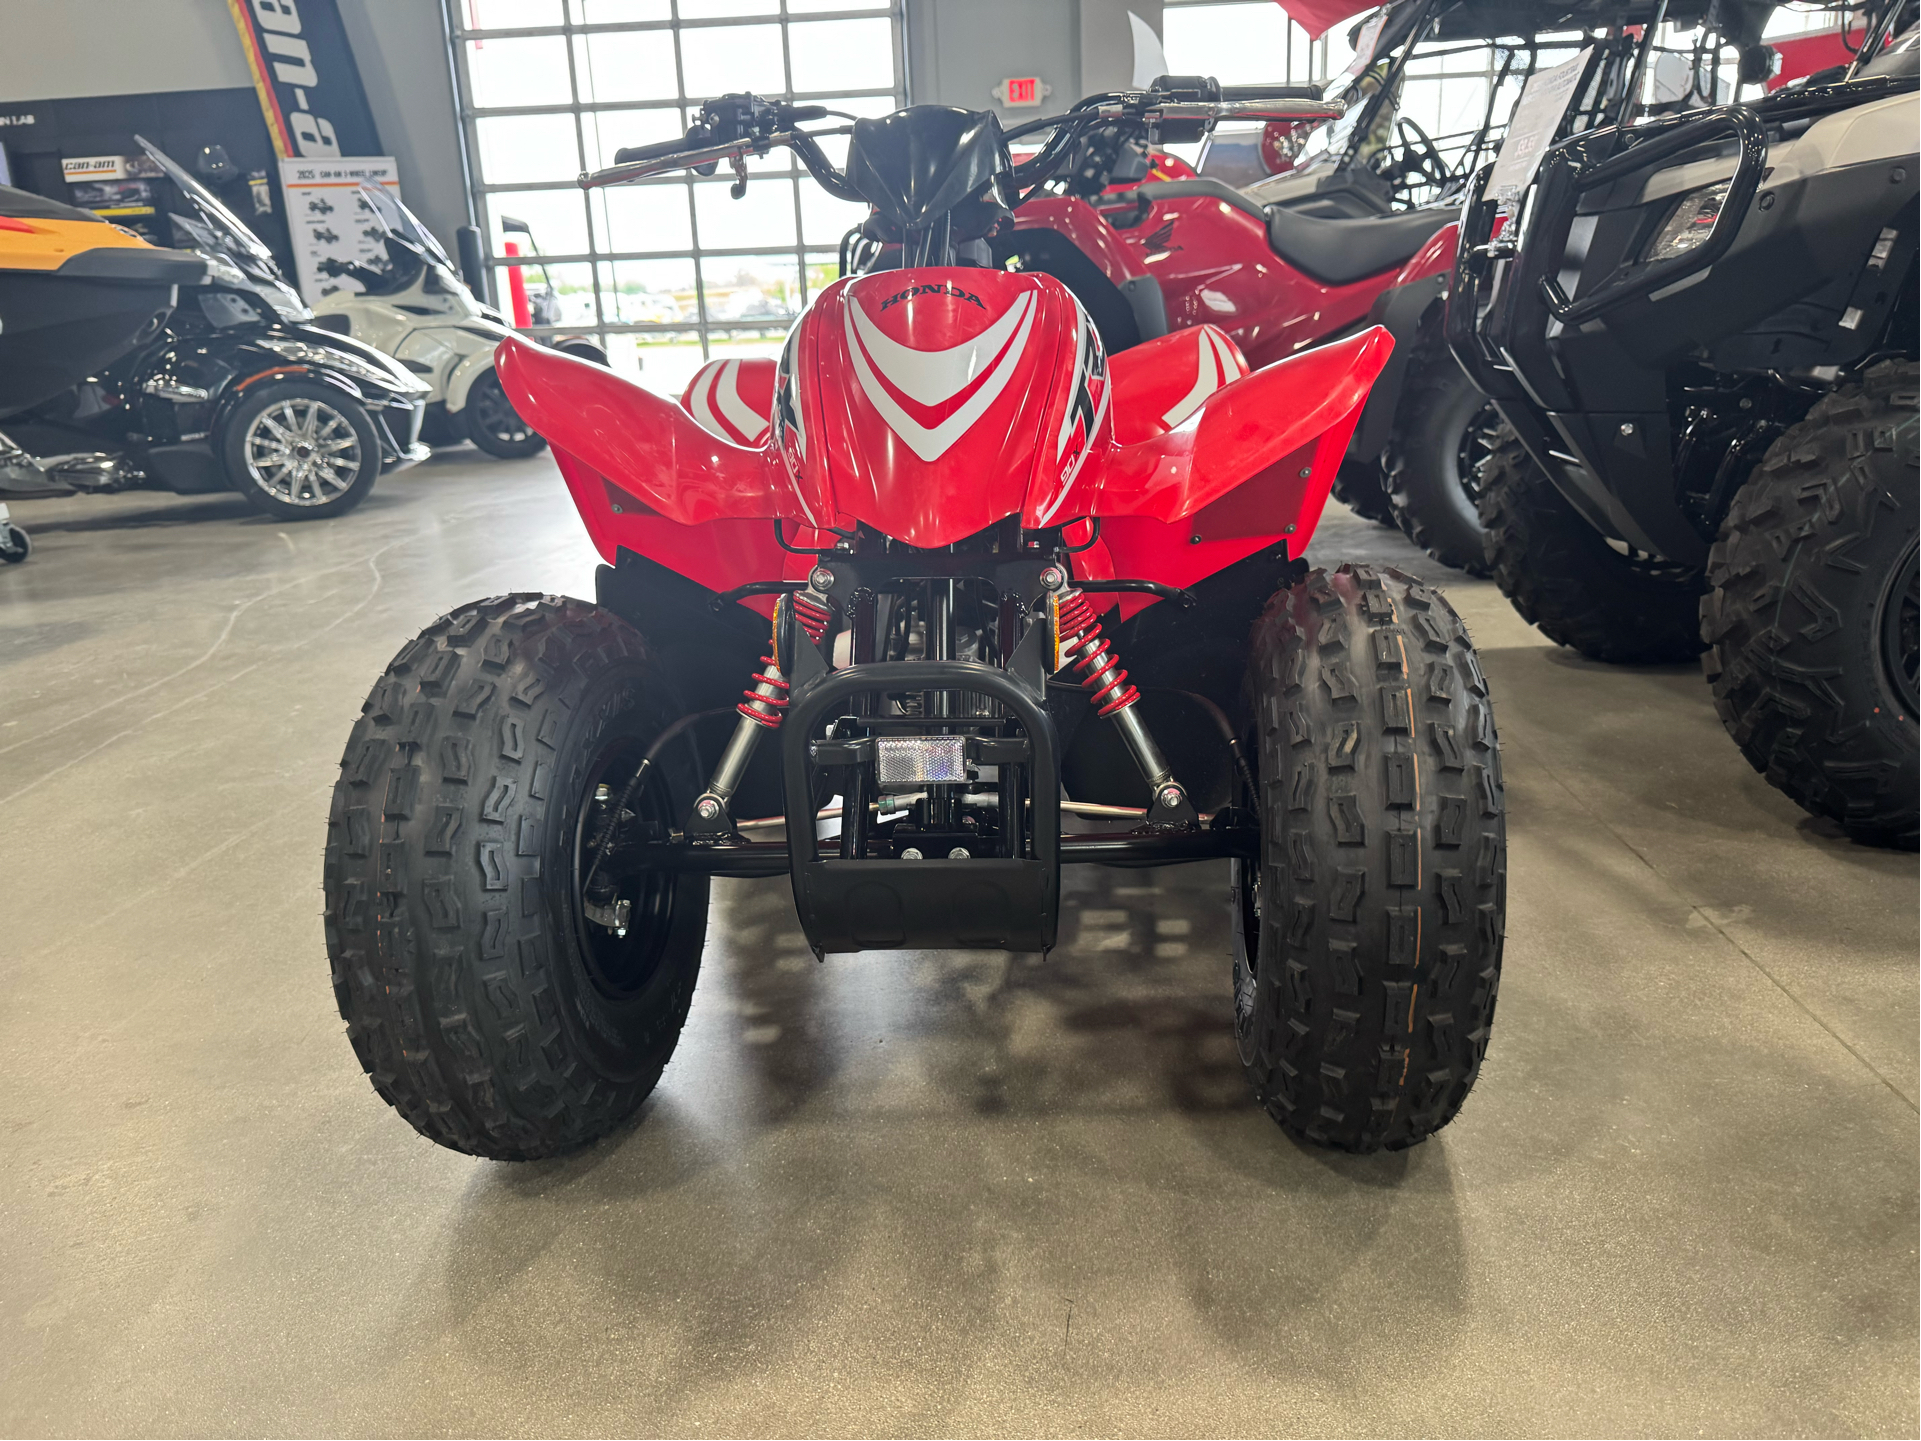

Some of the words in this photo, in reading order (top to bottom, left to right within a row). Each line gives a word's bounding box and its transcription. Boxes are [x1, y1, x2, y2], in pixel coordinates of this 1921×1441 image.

[1009, 78, 1035, 102] EXIT
[12, 114, 35, 126] LAB
[64, 160, 115, 171] can-am
[880, 284, 986, 312] HONDA
